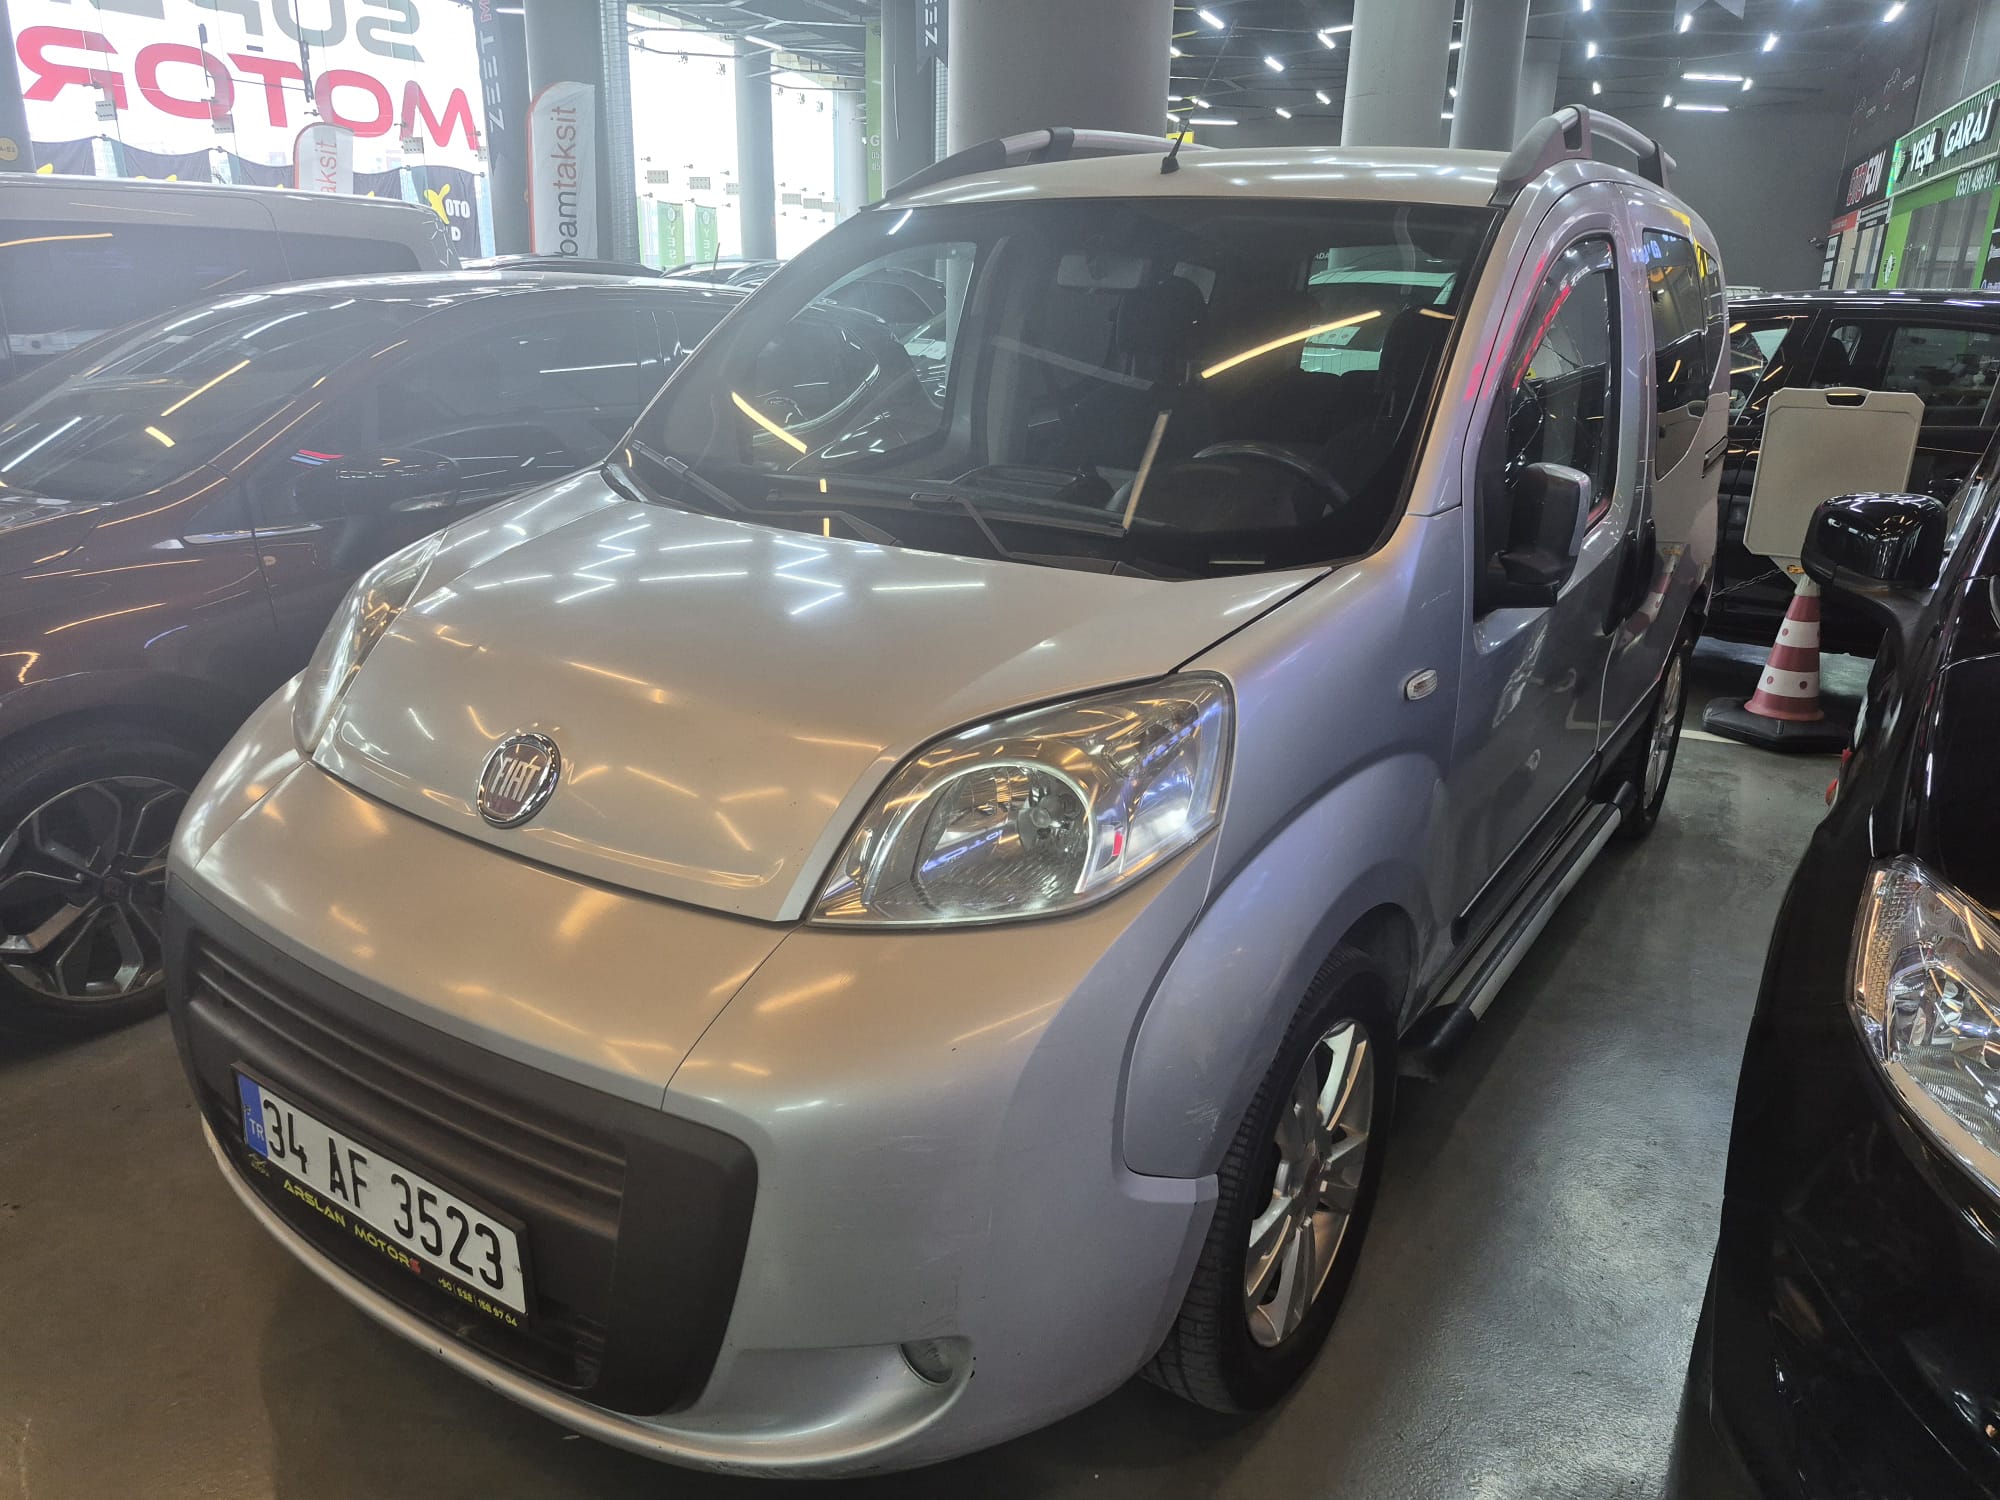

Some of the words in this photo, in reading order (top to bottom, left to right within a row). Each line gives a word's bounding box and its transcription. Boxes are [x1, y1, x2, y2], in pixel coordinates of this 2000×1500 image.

[925, 0, 938, 47] ZE
[480, 29, 505, 134] ZEET
[1943, 97, 1995, 158] GARAJ
[445, 198, 471, 219] OTO
[551, 106, 579, 257] bamtaksit
[490, 757, 541, 802] FIAT
[249, 1118, 265, 1142] TR
[263, 1099, 308, 1174] 34
[328, 1137, 367, 1209] AF
[391, 1173, 504, 1290] 3523
[283, 1179, 347, 1228] ARSLAN
